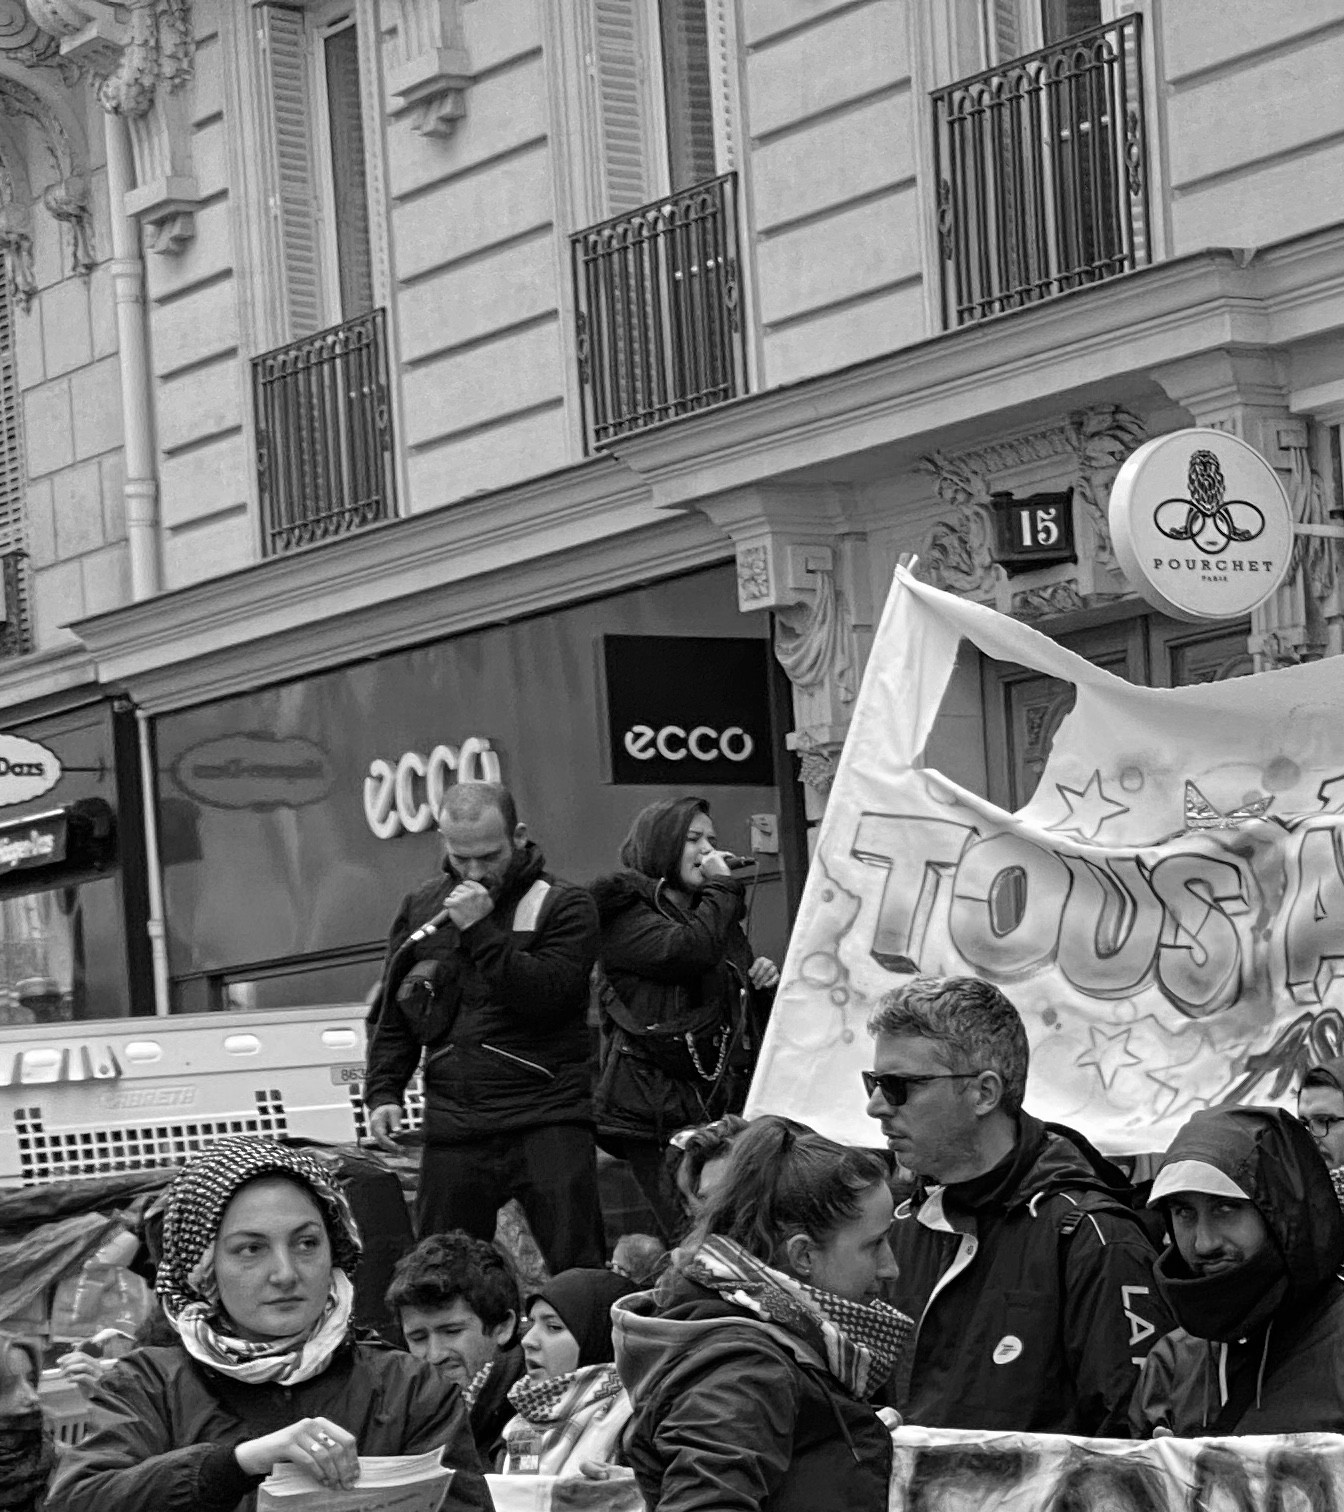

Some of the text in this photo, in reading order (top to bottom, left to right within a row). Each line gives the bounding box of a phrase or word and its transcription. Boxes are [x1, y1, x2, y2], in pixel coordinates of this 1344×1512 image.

[1019, 508, 1059, 547] 15
[1152, 556, 1275, 573] POURCHET
[626, 724, 754, 762] ecco
[852, 810, 1253, 1018] TOUS
